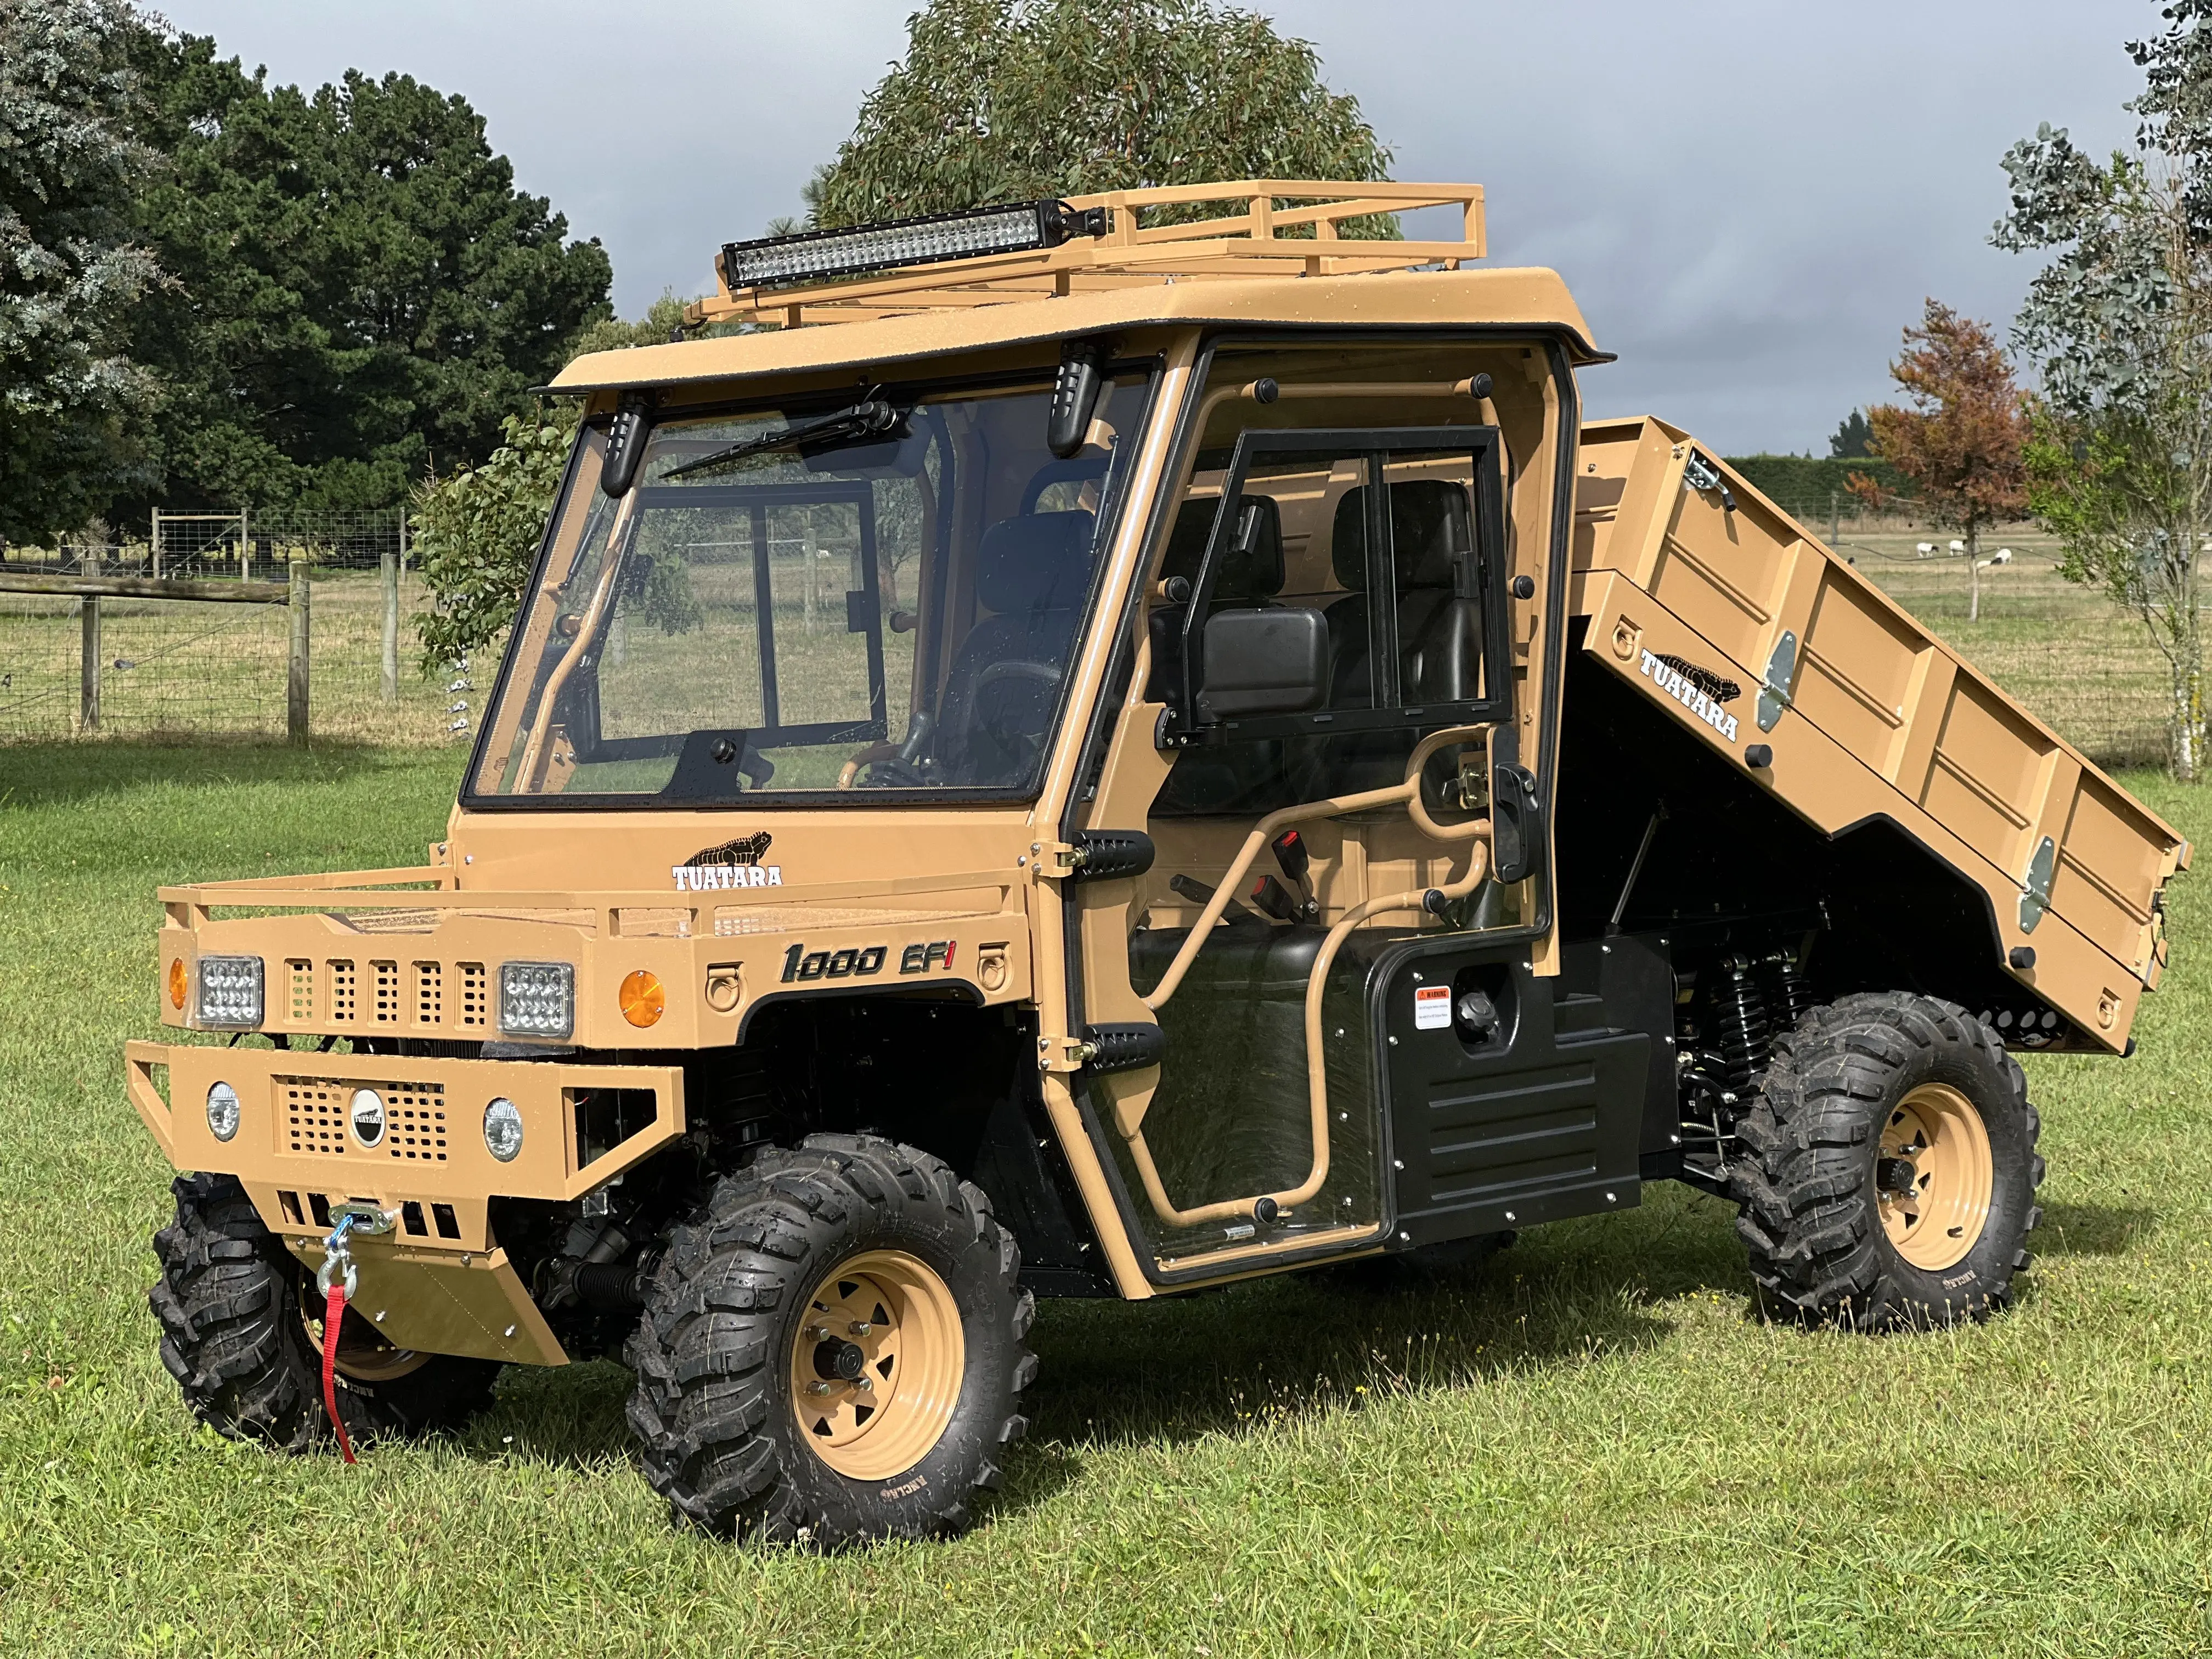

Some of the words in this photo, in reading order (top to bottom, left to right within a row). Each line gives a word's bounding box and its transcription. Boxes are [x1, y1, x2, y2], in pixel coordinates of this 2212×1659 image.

[1639, 647, 1739, 743] TUATARA
[672, 865, 783, 891] TUATARA
[780, 944, 888, 984] 1000
[898, 940, 957, 975] EFI
[354, 1116, 382, 1124] TUATARA
[889, 1475, 928, 1499] ANCLA
